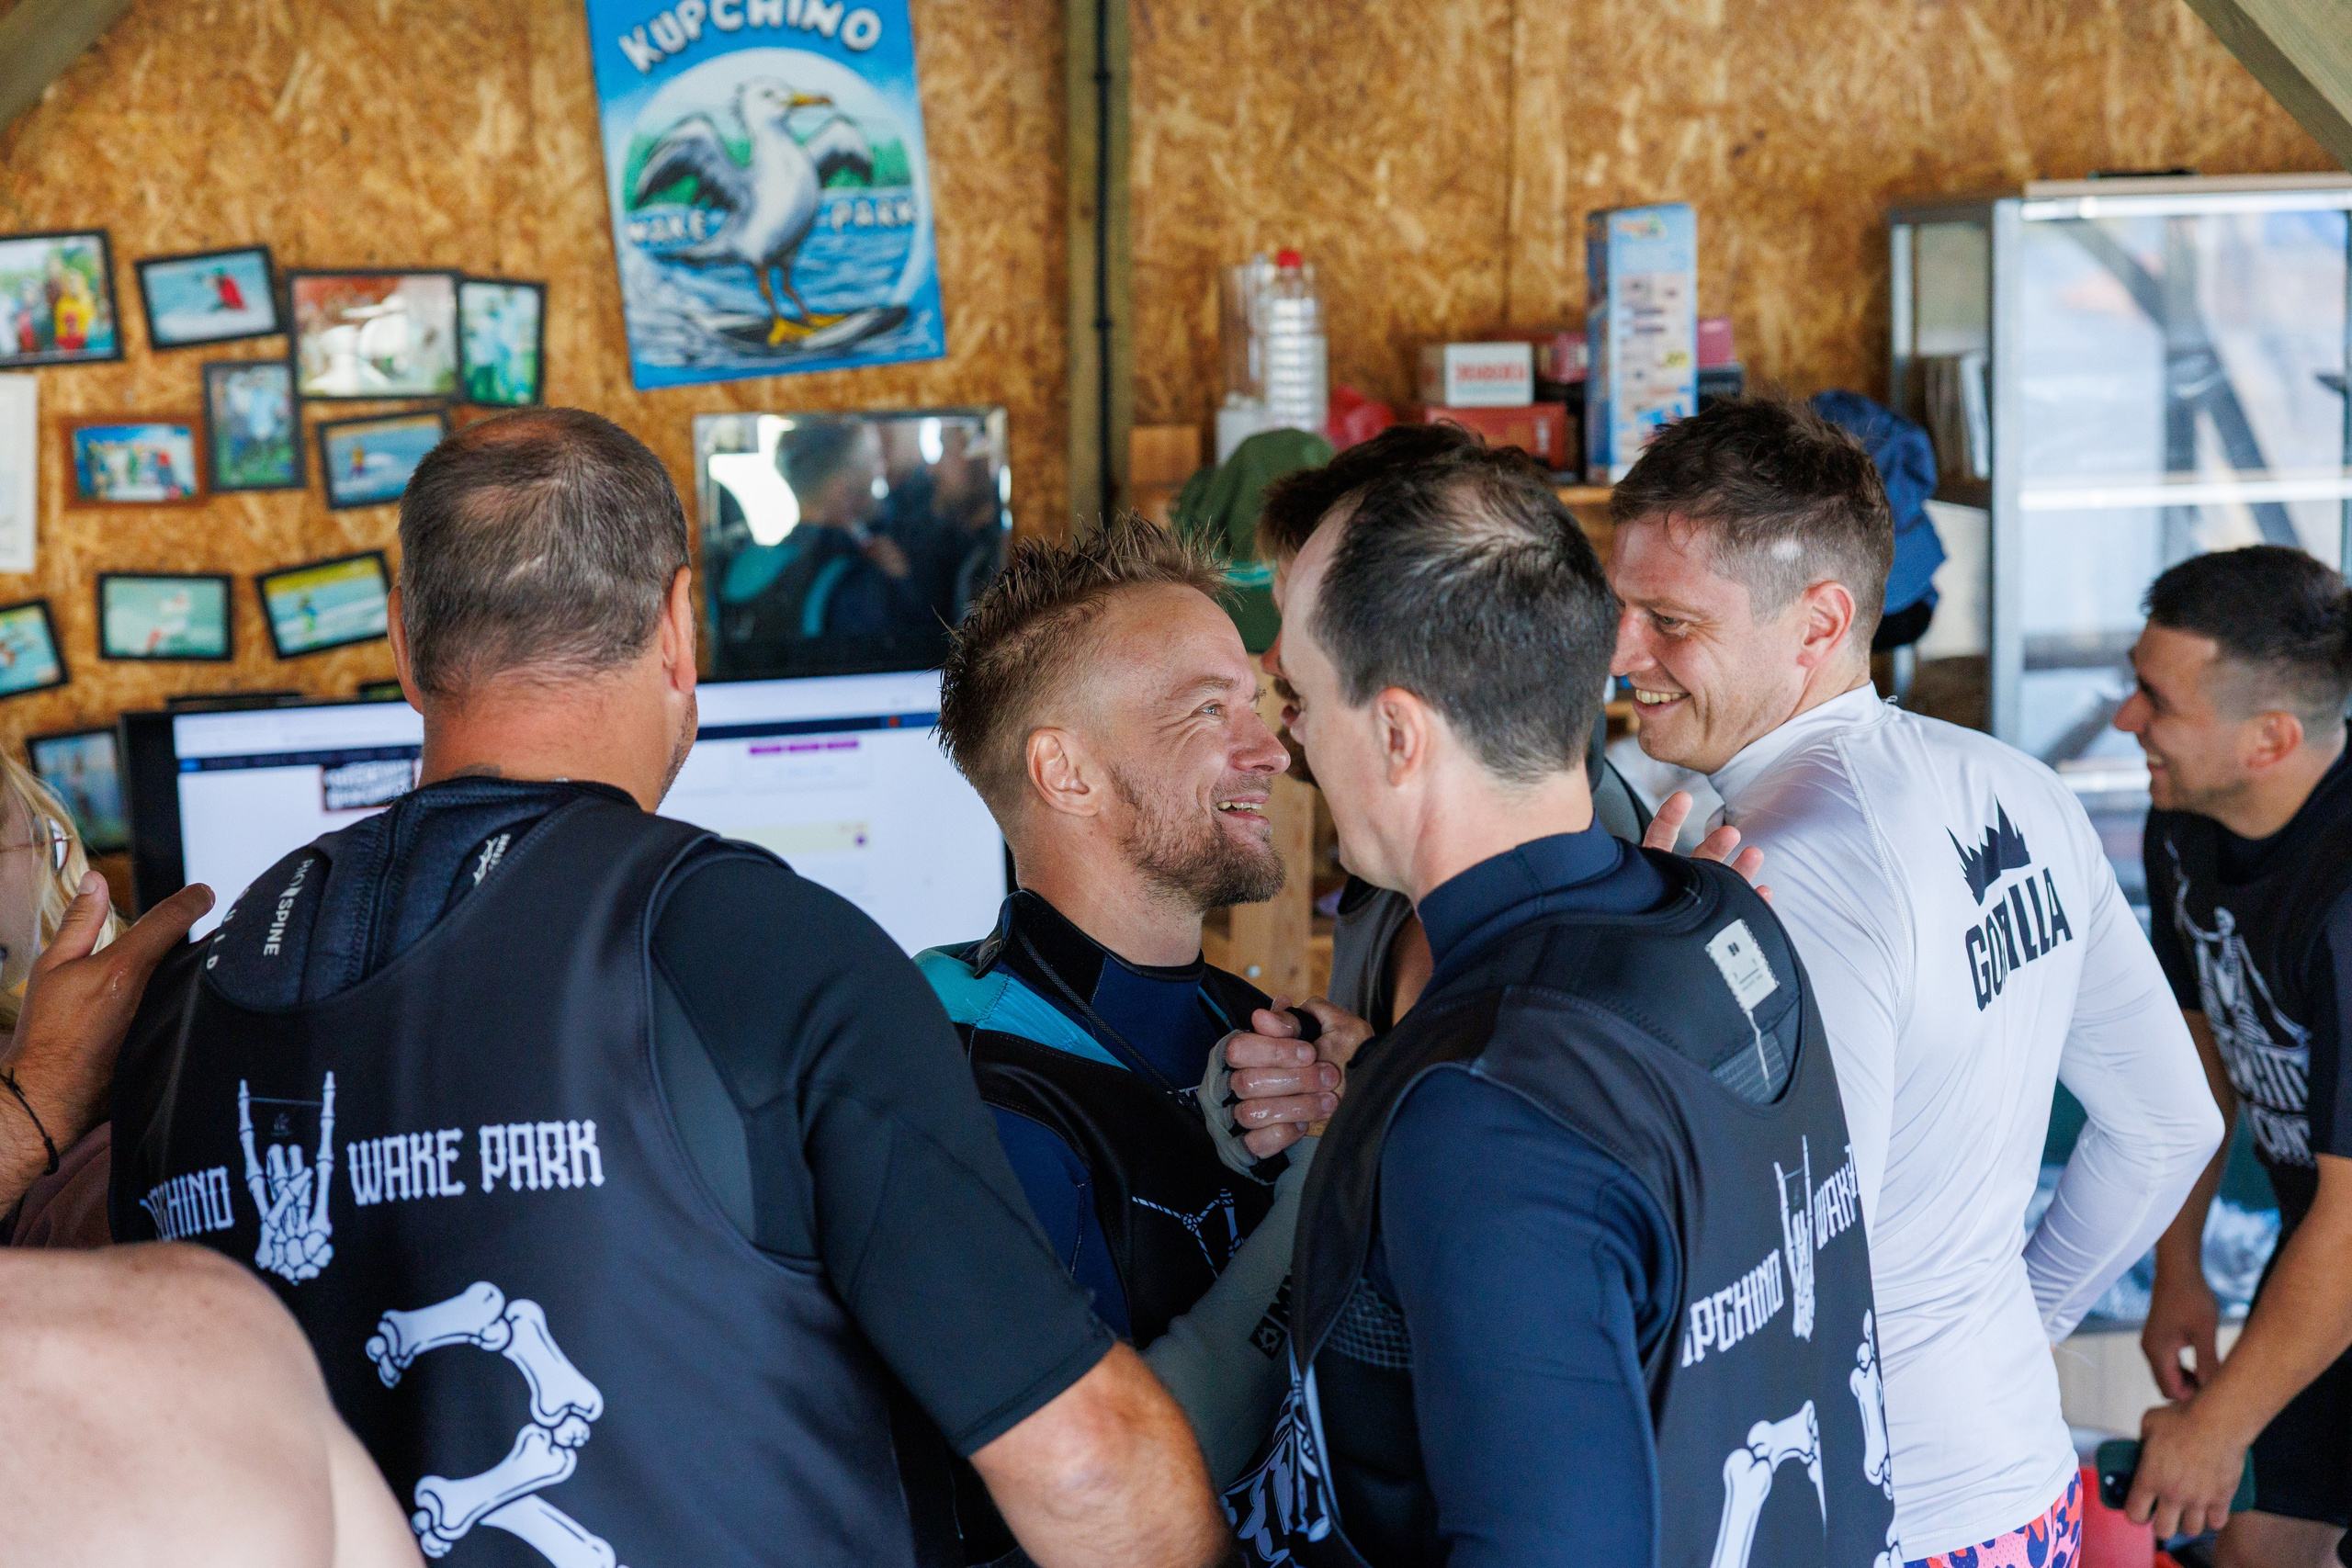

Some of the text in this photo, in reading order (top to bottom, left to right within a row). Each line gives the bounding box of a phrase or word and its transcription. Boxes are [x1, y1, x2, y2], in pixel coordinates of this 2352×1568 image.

[617, 0, 882, 73] KUPCHINO
[831, 198, 915, 233] PARK
[346, 1127, 467, 1207] WAKE
[478, 1119, 606, 1193] PARK
